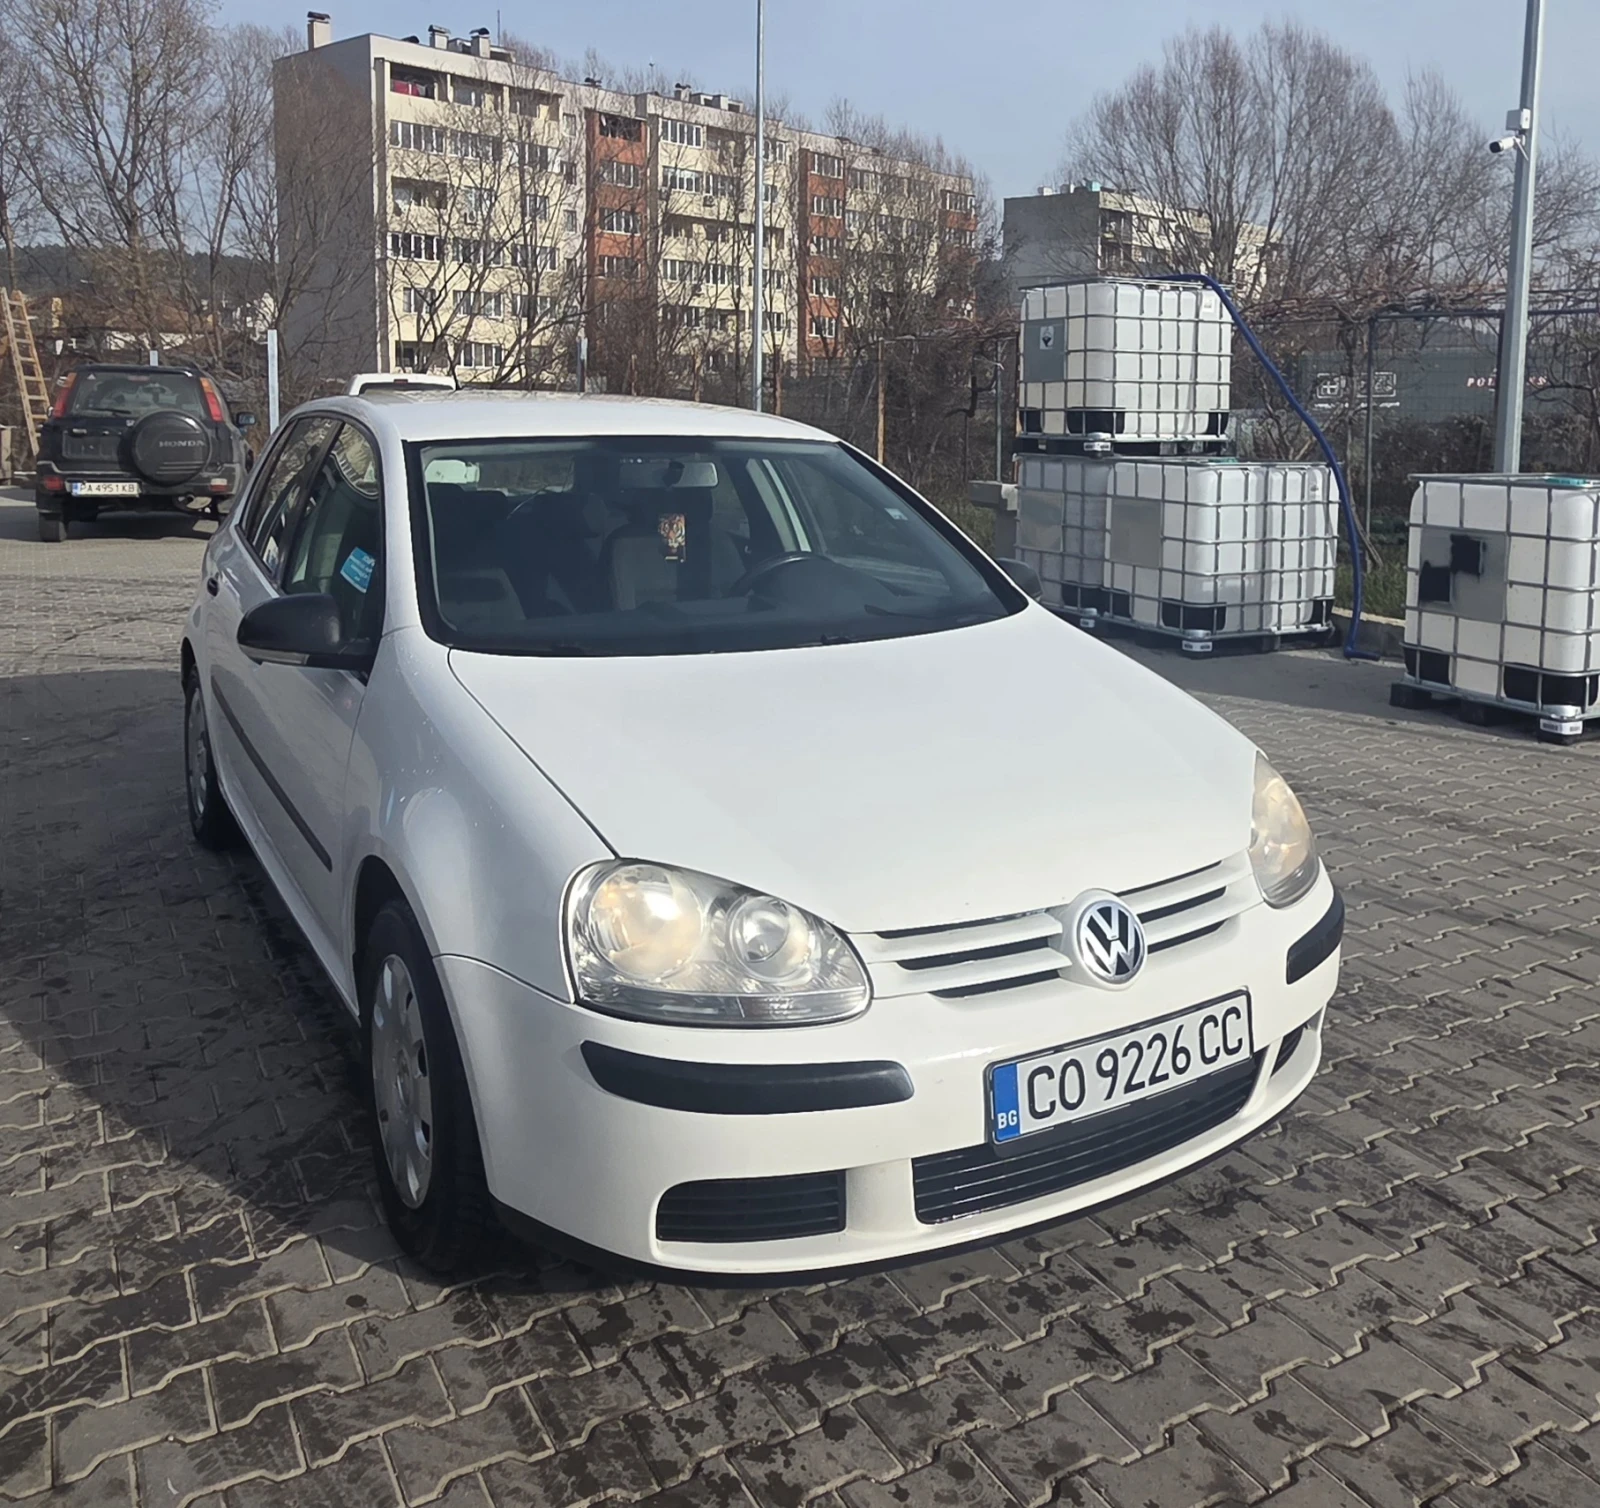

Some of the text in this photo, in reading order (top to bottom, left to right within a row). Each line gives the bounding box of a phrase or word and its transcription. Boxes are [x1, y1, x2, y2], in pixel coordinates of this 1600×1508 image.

[158, 440, 206, 448] HONDA
[96, 484, 119, 493] 4951
[122, 484, 135, 493] KB
[1027, 1006, 1244, 1120] CO 9226 CC
[997, 1110, 1018, 1130] BG
